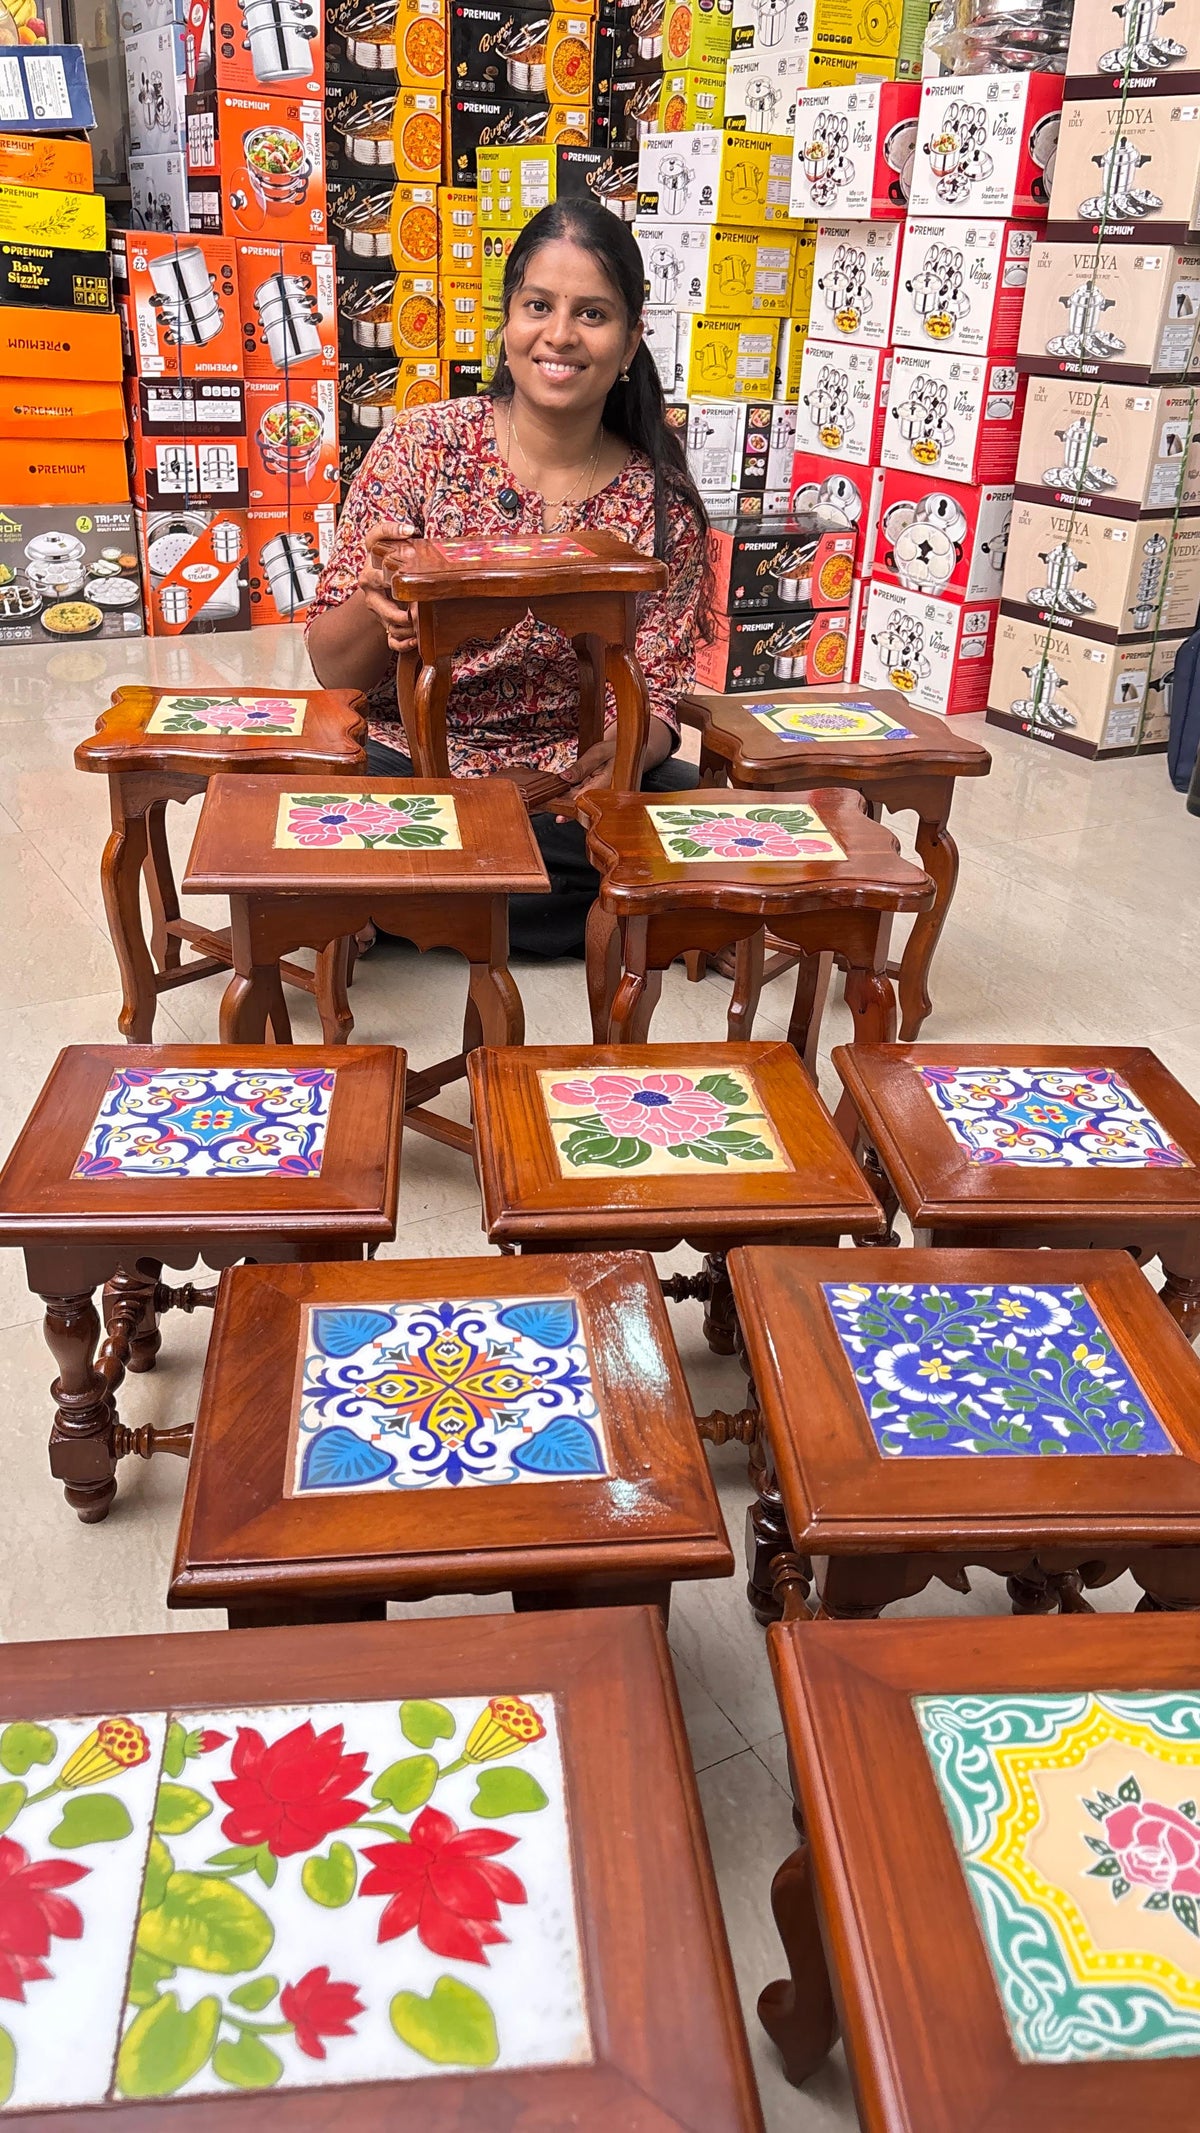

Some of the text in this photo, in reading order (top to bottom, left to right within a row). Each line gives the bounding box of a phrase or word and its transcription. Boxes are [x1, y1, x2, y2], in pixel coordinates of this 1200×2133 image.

[464, 9, 500, 20] PREMIUM
[479, 15, 514, 52] Biryani
[733, 62, 759, 74] PREMIUM
[821, 58, 858, 69] PREMIUM
[616, 82, 636, 90] PREMIUM
[931, 85, 964, 96] PREMIUM
[232, 99, 270, 110] PREMIUM
[325, 91, 358, 122] Gravy
[803, 96, 830, 106] PREMIUM
[464, 104, 500, 114] PREMIUM
[1106, 109, 1154, 125] VEDYA
[479, 108, 514, 144] Biryani
[1068, 119, 1084, 127] IDLY
[992, 121, 1016, 141] Vegan
[853, 127, 873, 147] Vegan
[1006, 137, 1013, 145] 15
[647, 140, 673, 149] PREMIUM
[733, 140, 771, 151] PREMIUM
[568, 152, 601, 163] PREMIUM
[586, 156, 613, 186] Gravy
[4, 187, 39, 199] PREMIUM
[312, 211, 321, 219] 22
[638, 231, 664, 239] PREMIUM
[825, 227, 850, 237] PREMIUM
[914, 226, 946, 236] PREMIUM
[722, 233, 759, 243] PREMIUM
[10, 246, 54, 258] PREMIUM
[12, 260, 43, 276] Baby
[135, 260, 147, 270] 22
[1037, 260, 1052, 268] IDLY
[1073, 255, 1117, 270] VEDYA
[871, 262, 890, 281] Vegan
[969, 264, 992, 284] Vegan
[8, 271, 50, 286] Sizzler
[456, 282, 482, 290] PREMIU
[139, 315, 148, 347] STEAMER
[703, 321, 741, 331] PREMIUM
[8, 339, 61, 351] PREMIUM
[810, 347, 834, 359] PREMIUM
[195, 364, 232, 372] PREMIUM
[901, 357, 930, 369] PREMIUM
[245, 382, 280, 391] PREMIUM
[853, 385, 871, 403] Vegan
[24, 405, 73, 417] PREMIUM
[954, 396, 976, 416] Vegan
[965, 413, 972, 421] 15
[38, 464, 85, 474] PREMIUM
[94, 515, 130, 524] TRI-PLY
[1051, 517, 1089, 536] VEDYA
[744, 542, 777, 551] PREMIUM
[878, 589, 906, 604] PREMIUM
[742, 623, 774, 632] PREMIUM
[929, 634, 950, 653] Vegan
[1034, 634, 1071, 656] VEDYA
